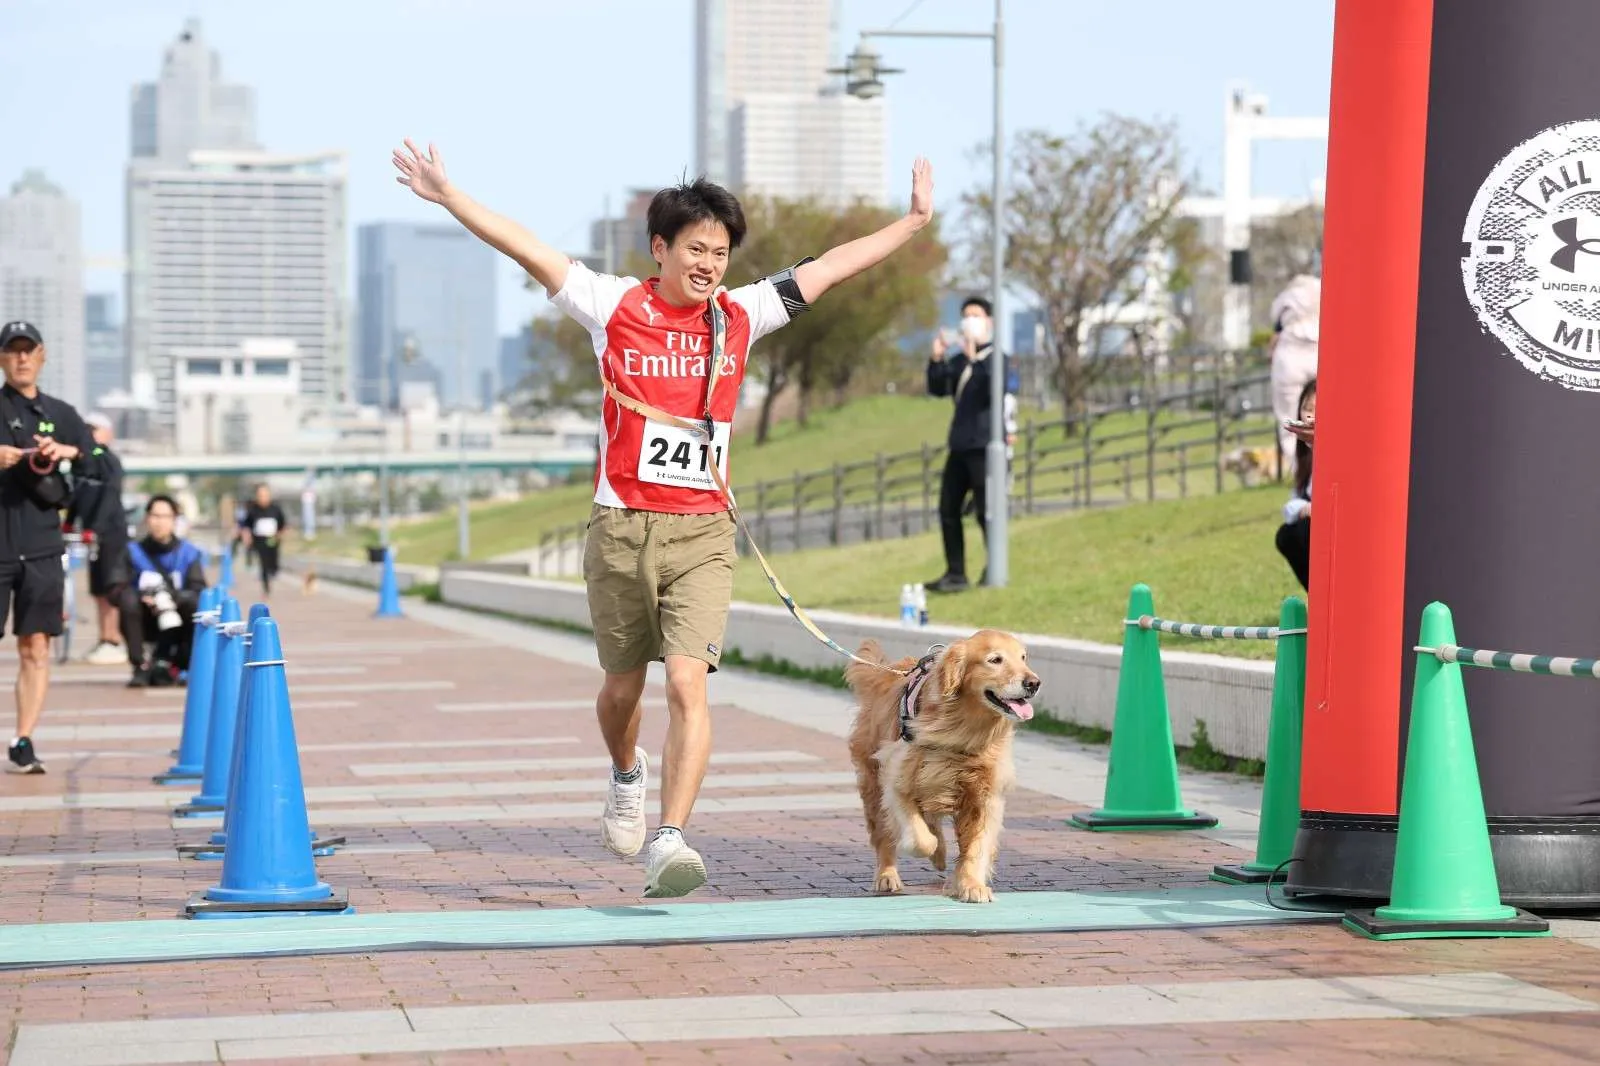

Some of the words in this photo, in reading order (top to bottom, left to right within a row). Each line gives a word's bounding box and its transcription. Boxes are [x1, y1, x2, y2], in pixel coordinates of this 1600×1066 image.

[1539, 161, 1591, 203] ALL
[1542, 282, 1587, 292] UNDER
[666, 331, 702, 353] Fly
[1553, 319, 1600, 352] MI
[623, 348, 736, 377] Emiraes
[648, 437, 722, 472] 2411
[667, 473, 691, 481] UNDER
